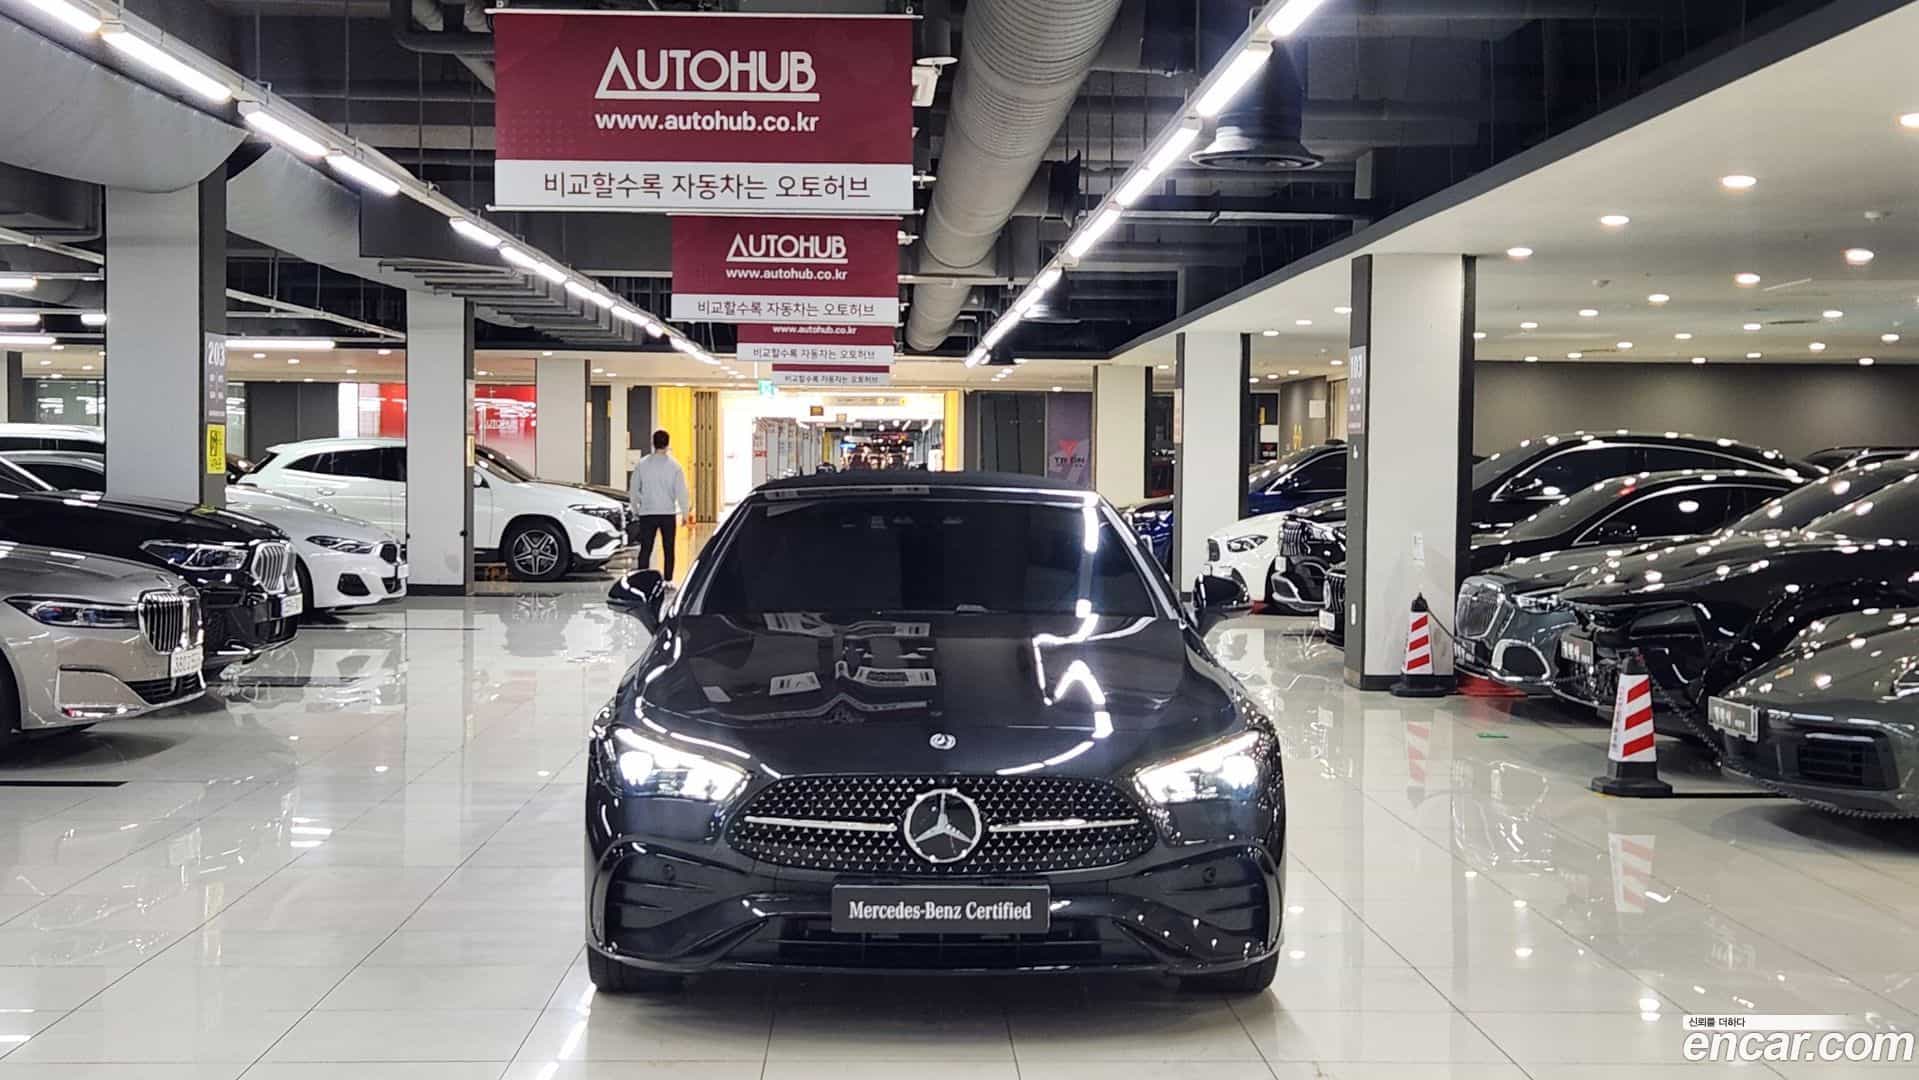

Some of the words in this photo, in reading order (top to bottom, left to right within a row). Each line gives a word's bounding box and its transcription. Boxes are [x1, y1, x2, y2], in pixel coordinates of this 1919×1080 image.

[595, 46, 819, 101] AUTOHUB
[595, 110, 819, 132] www.autohub.co.kr
[544, 173, 663, 200] 비교할수록
[672, 174, 767, 200] 자동차는
[776, 176, 870, 199] 오토허브
[726, 233, 848, 263] AUTOHUB
[726, 267, 847, 280] www.autohub.co.kr
[698, 300, 762, 316] 비교할수록
[767, 302, 819, 317] 자동차는
[825, 303, 875, 317] 오토허브
[208, 341, 225, 366] 203
[849, 901, 962, 920] Mercedes-Benz
[965, 901, 1032, 919] Certified
